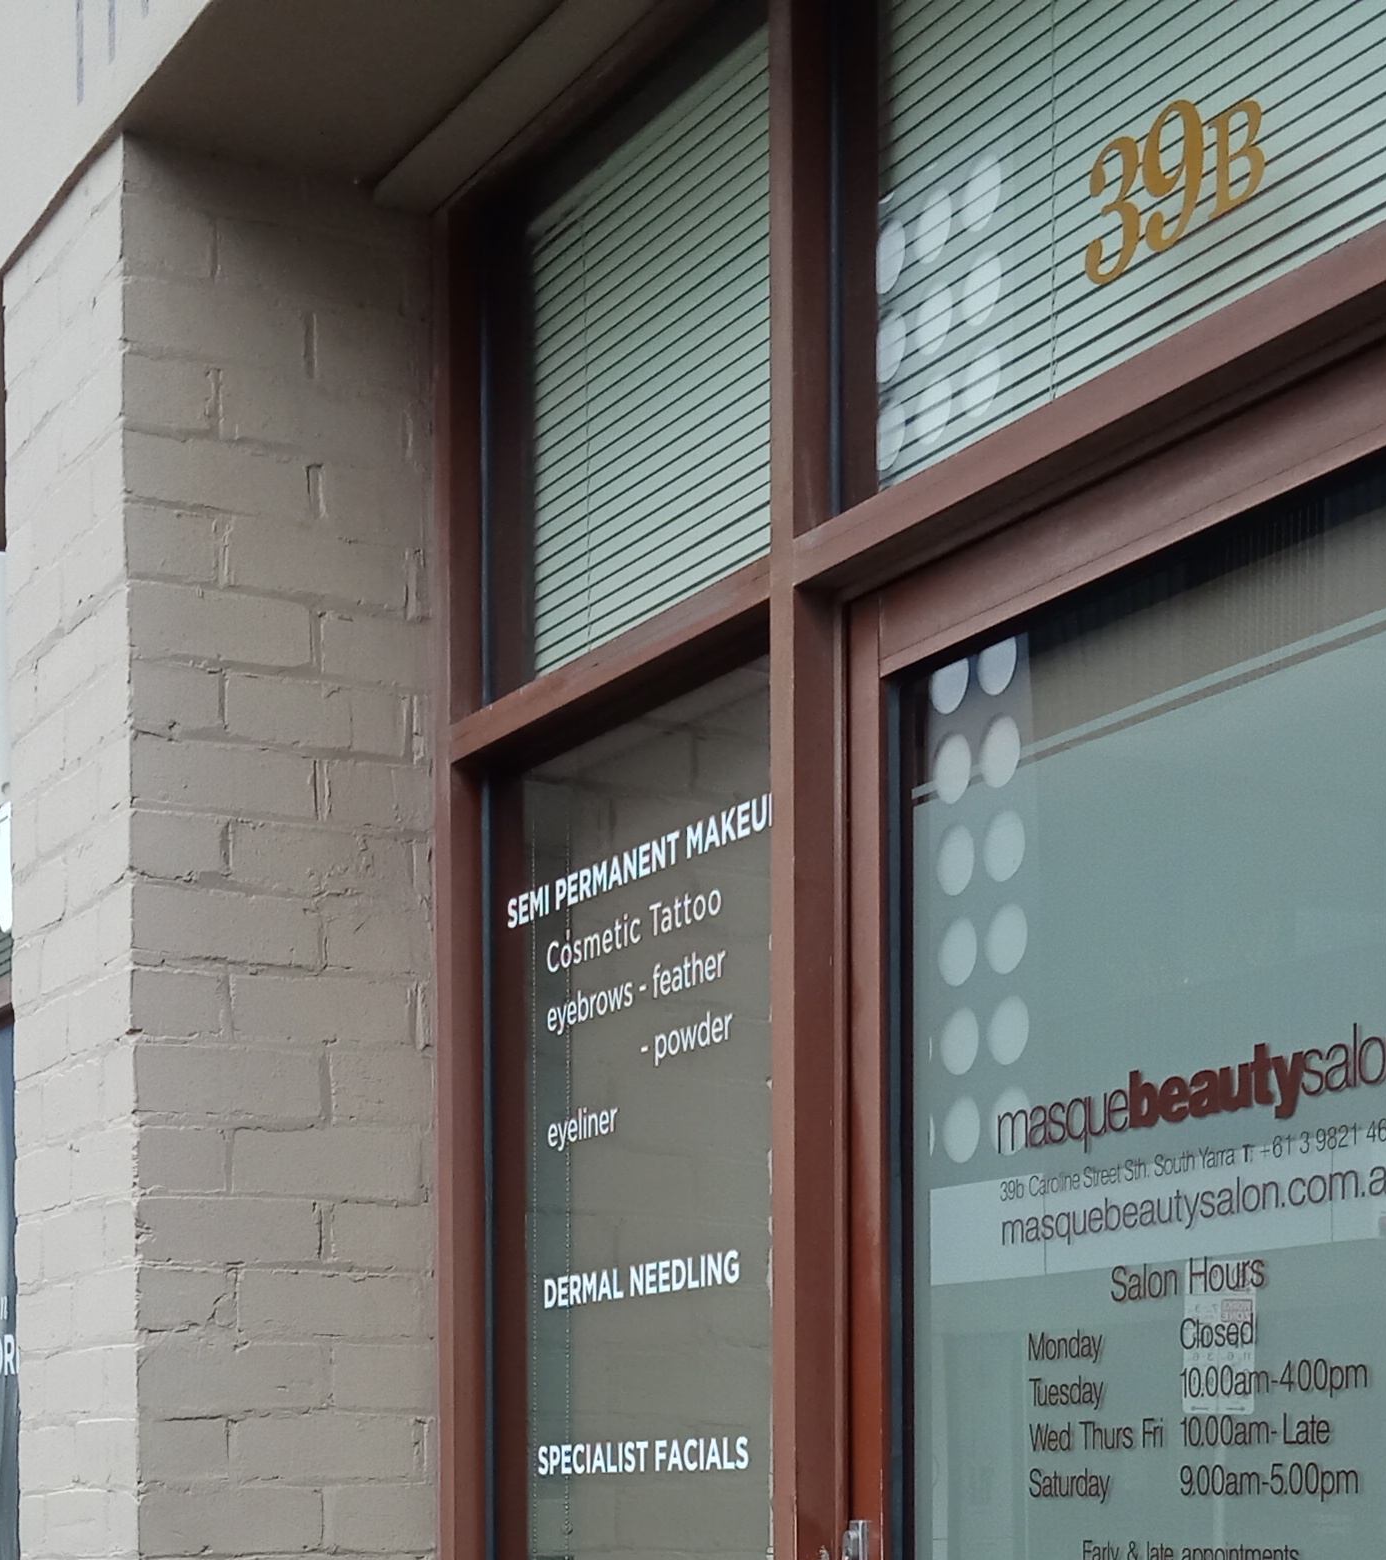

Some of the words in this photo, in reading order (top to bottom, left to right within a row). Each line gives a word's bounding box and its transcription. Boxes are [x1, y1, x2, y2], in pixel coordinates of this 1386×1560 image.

[1085, 99, 1265, 284] 39B
[507, 884, 550, 929] SEMI
[555, 830, 680, 911] PERMANENT
[546, 912, 641, 973] Cosmetic
[649, 888, 722, 937] Tattoo
[547, 981, 633, 1036] eyebrows
[652, 949, 727, 999] feather
[654, 1013, 733, 1067] powder
[547, 1106, 619, 1152] eyeliner
[1000, 1178, 1024, 1201] 39b
[1029, 1172, 1080, 1197] Caroline
[1083, 1165, 1121, 1188] Street
[1124, 1159, 1149, 1181] Sth.
[1154, 1150, 1195, 1177] South
[1198, 1147, 1235, 1169] Yarra
[1260, 1134, 1292, 1158] +61
[1300, 1131, 1310, 1154] 3
[1315, 1122, 1358, 1151] 9821
[543, 1268, 623, 1309] DERMAL
[629, 1248, 741, 1297] NEEDLING
[1111, 1265, 1178, 1301] Salon
[1189, 1257, 1266, 1295] Hours
[1028, 1329, 1102, 1363] Monday
[1180, 1313, 1254, 1350] Closed
[1029, 1375, 1103, 1410] Tuesday
[538, 1440, 649, 1476] SPECIALIST
[655, 1435, 749, 1472] FACIALS
[1029, 1421, 1071, 1452] Wed
[1079, 1420, 1134, 1449] Thurs
[1142, 1417, 1164, 1448] Fri
[1282, 1413, 1331, 1445] Late
[1029, 1468, 1110, 1503] Saturday
